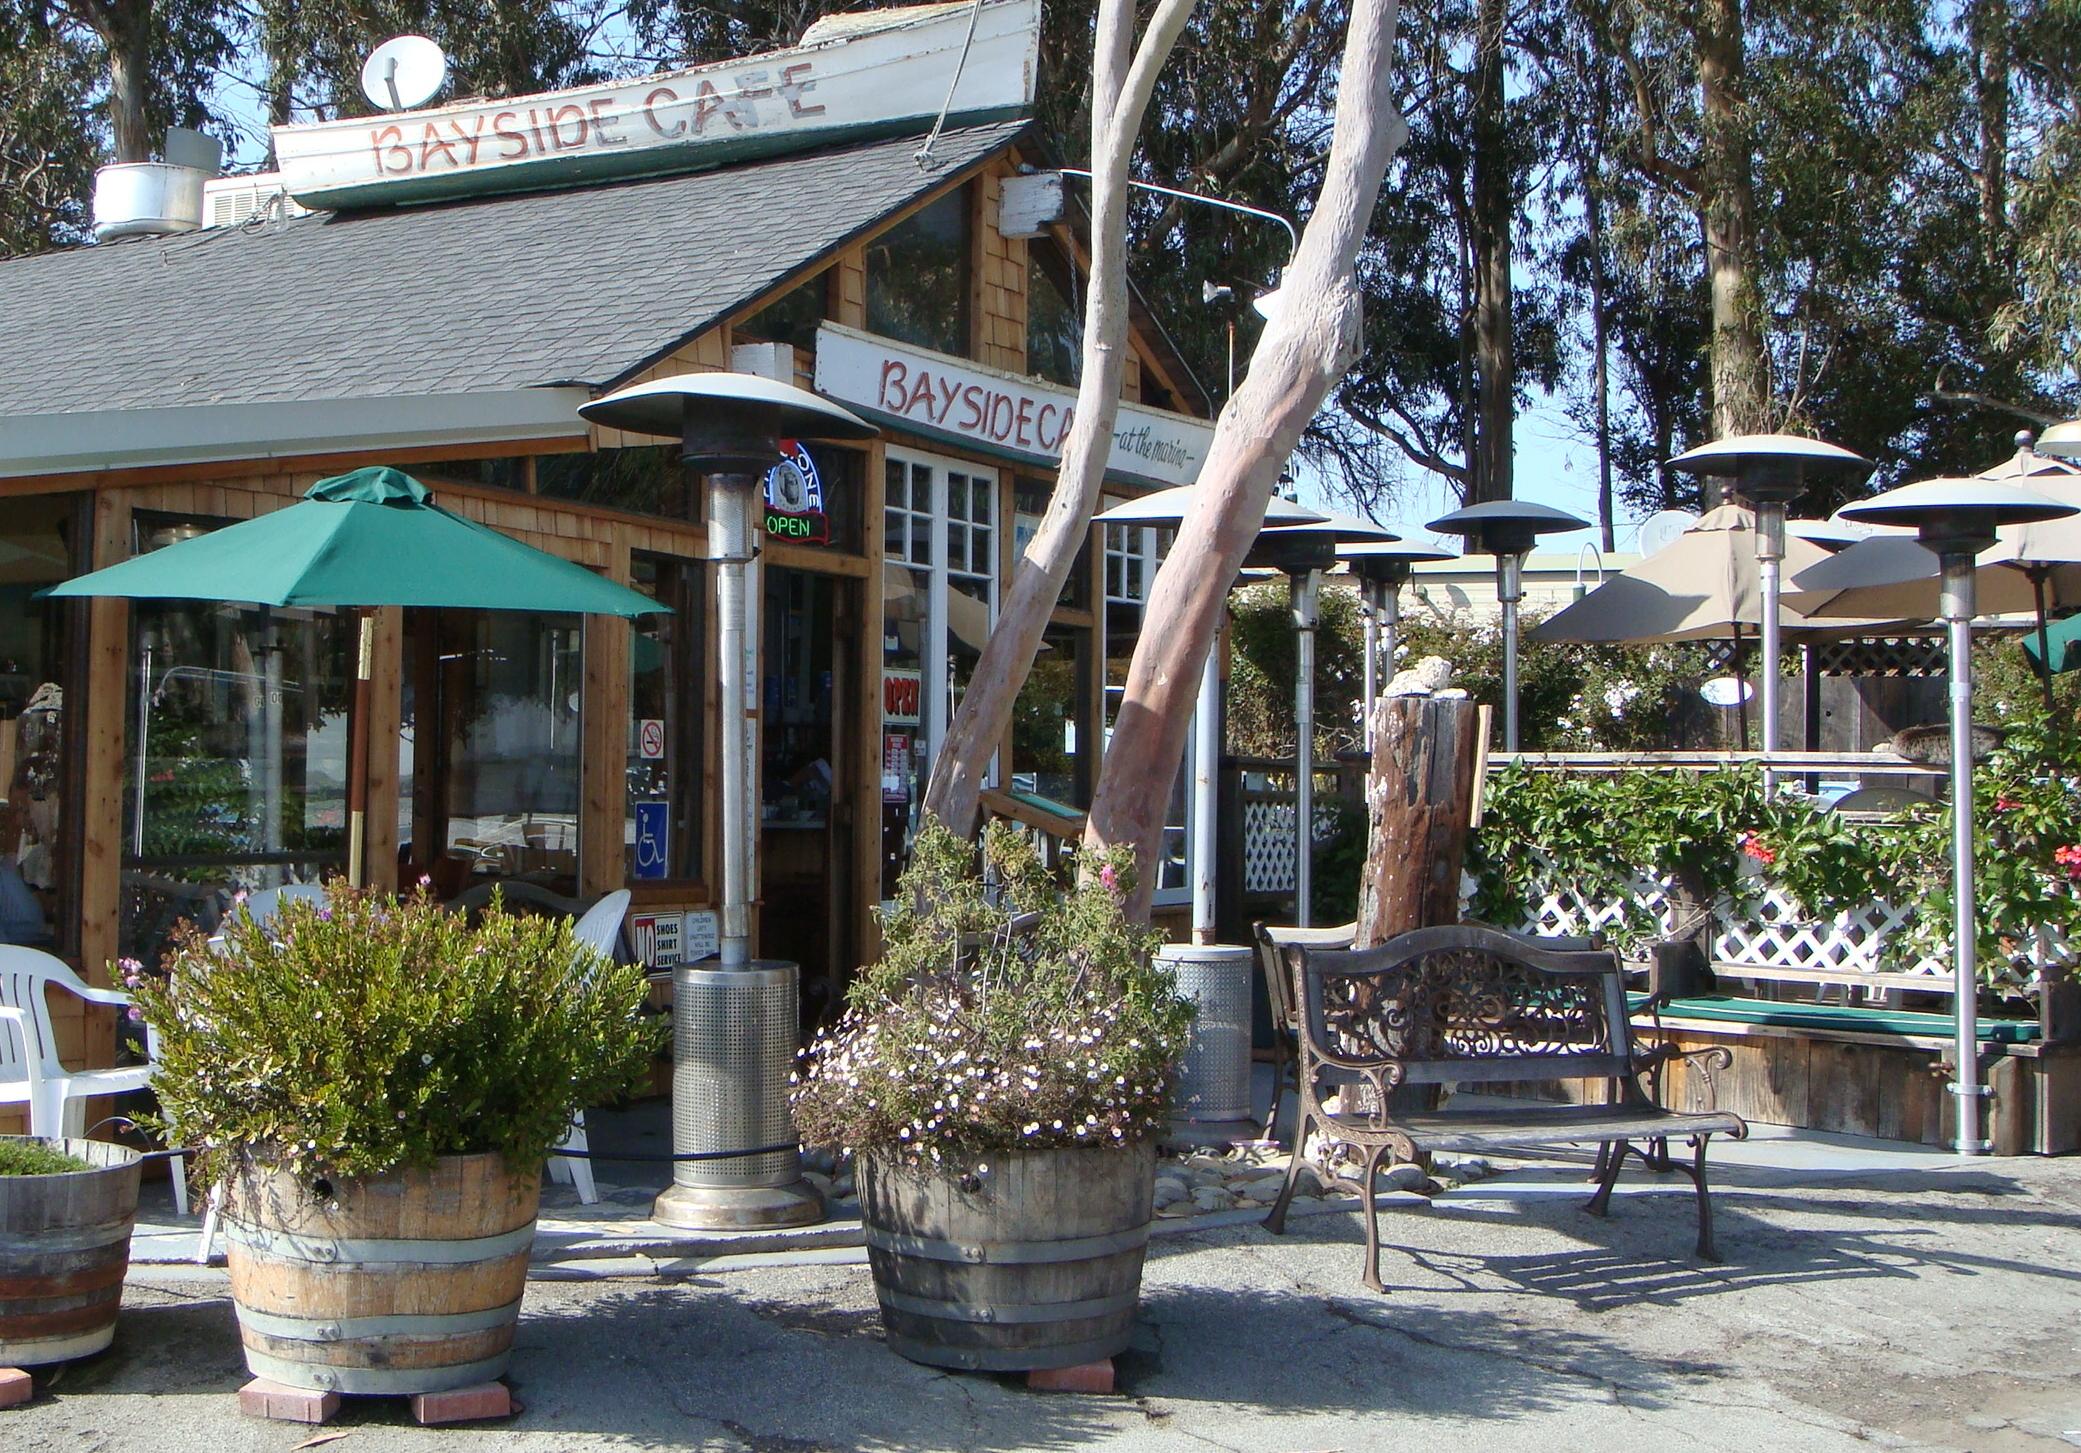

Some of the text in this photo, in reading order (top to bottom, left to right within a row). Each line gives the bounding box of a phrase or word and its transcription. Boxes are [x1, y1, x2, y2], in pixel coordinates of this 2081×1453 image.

[371, 62, 826, 175] BAYSIDE CAFE
[878, 359, 1079, 453] BAYSIDE CA
[1135, 426, 1152, 459] the
[767, 515, 810, 537] OPEN
[884, 677, 920, 717] OPEN
[635, 924, 655, 968] NO
[656, 923, 678, 936] SHOES
[656, 938, 678, 951] SHIRT
[656, 953, 681, 967] SERVICE
